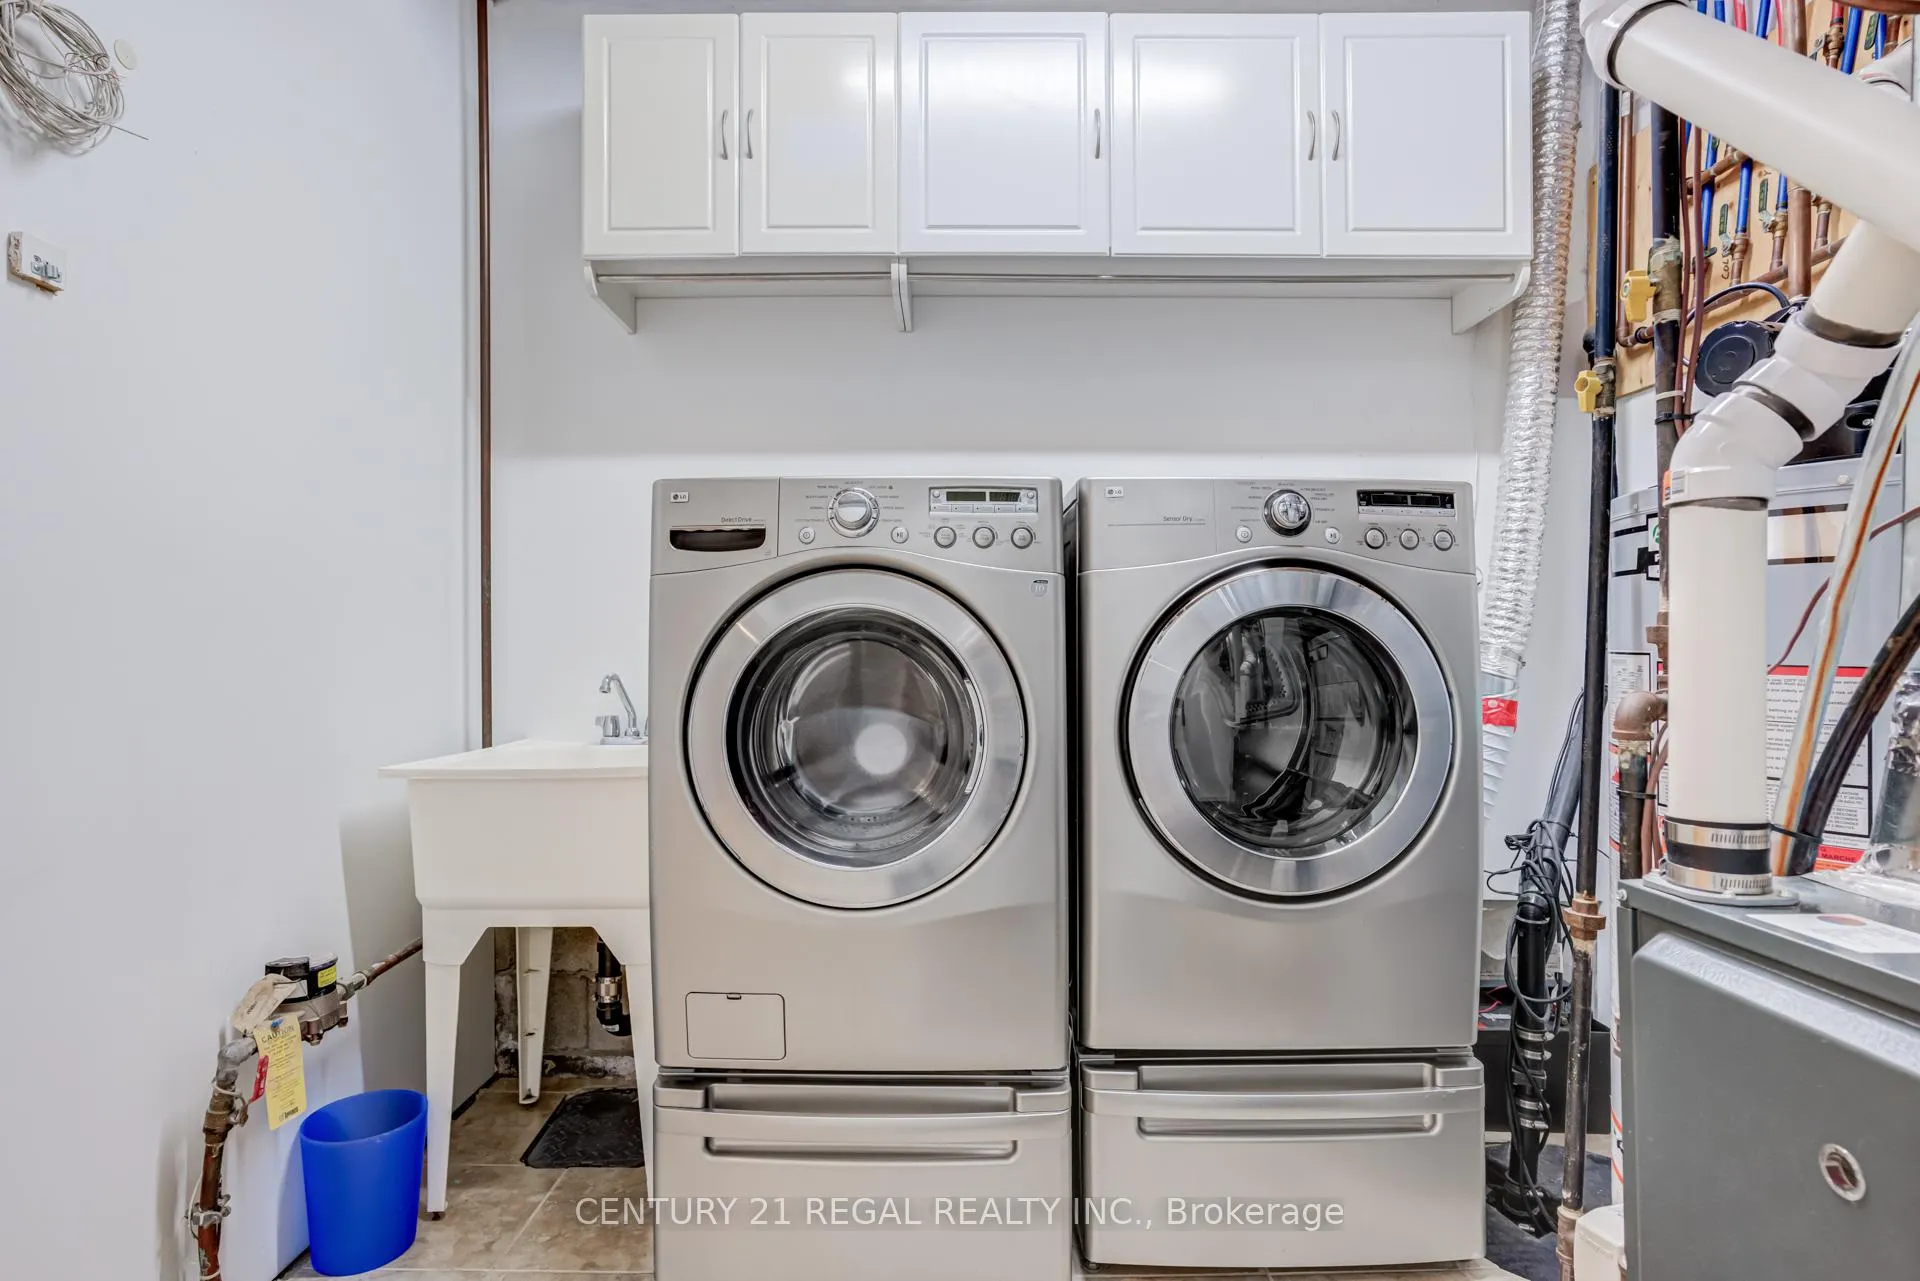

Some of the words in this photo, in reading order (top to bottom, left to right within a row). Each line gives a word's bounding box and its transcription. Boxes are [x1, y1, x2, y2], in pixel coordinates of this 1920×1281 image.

[1183, 515, 1193, 523] Dry
[1821, 853, 1857, 863] MARCHE
[261, 1025, 294, 1043] CAUTION
